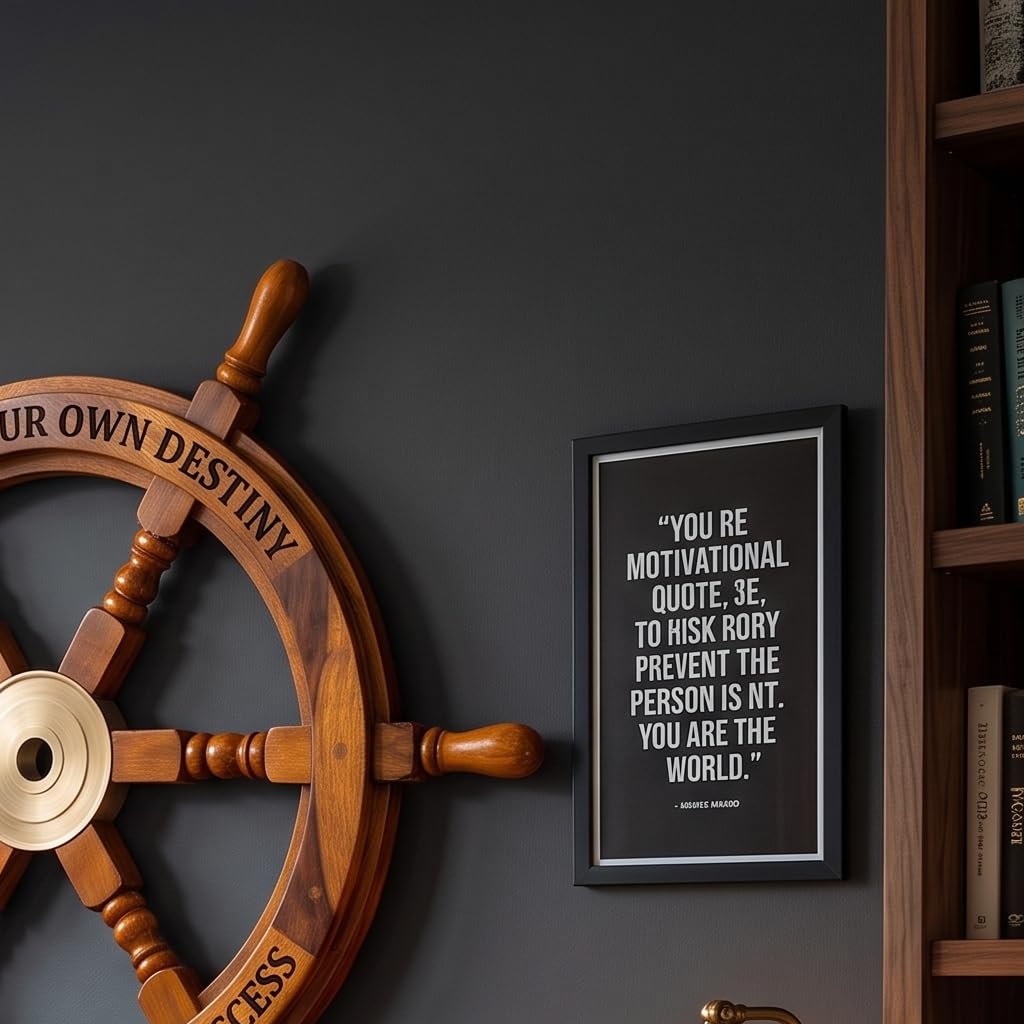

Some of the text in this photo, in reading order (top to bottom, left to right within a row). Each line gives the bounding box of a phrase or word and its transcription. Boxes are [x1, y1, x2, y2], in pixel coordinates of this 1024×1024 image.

[58, 403, 153, 447] OWN
[154, 429, 300, 561] DESTINY
[720, 507, 748, 538] RE
[627, 539, 789, 581] MOTIVATIONAL
[652, 580, 728, 614] QUOTE,
[634, 620, 661, 648] TO
[722, 610, 780, 642] RORY
[635, 646, 780, 682] PREVENT THE
[630, 681, 784, 716] PERSON IS NT.
[639, 716, 776, 750] YOU ARE THE
